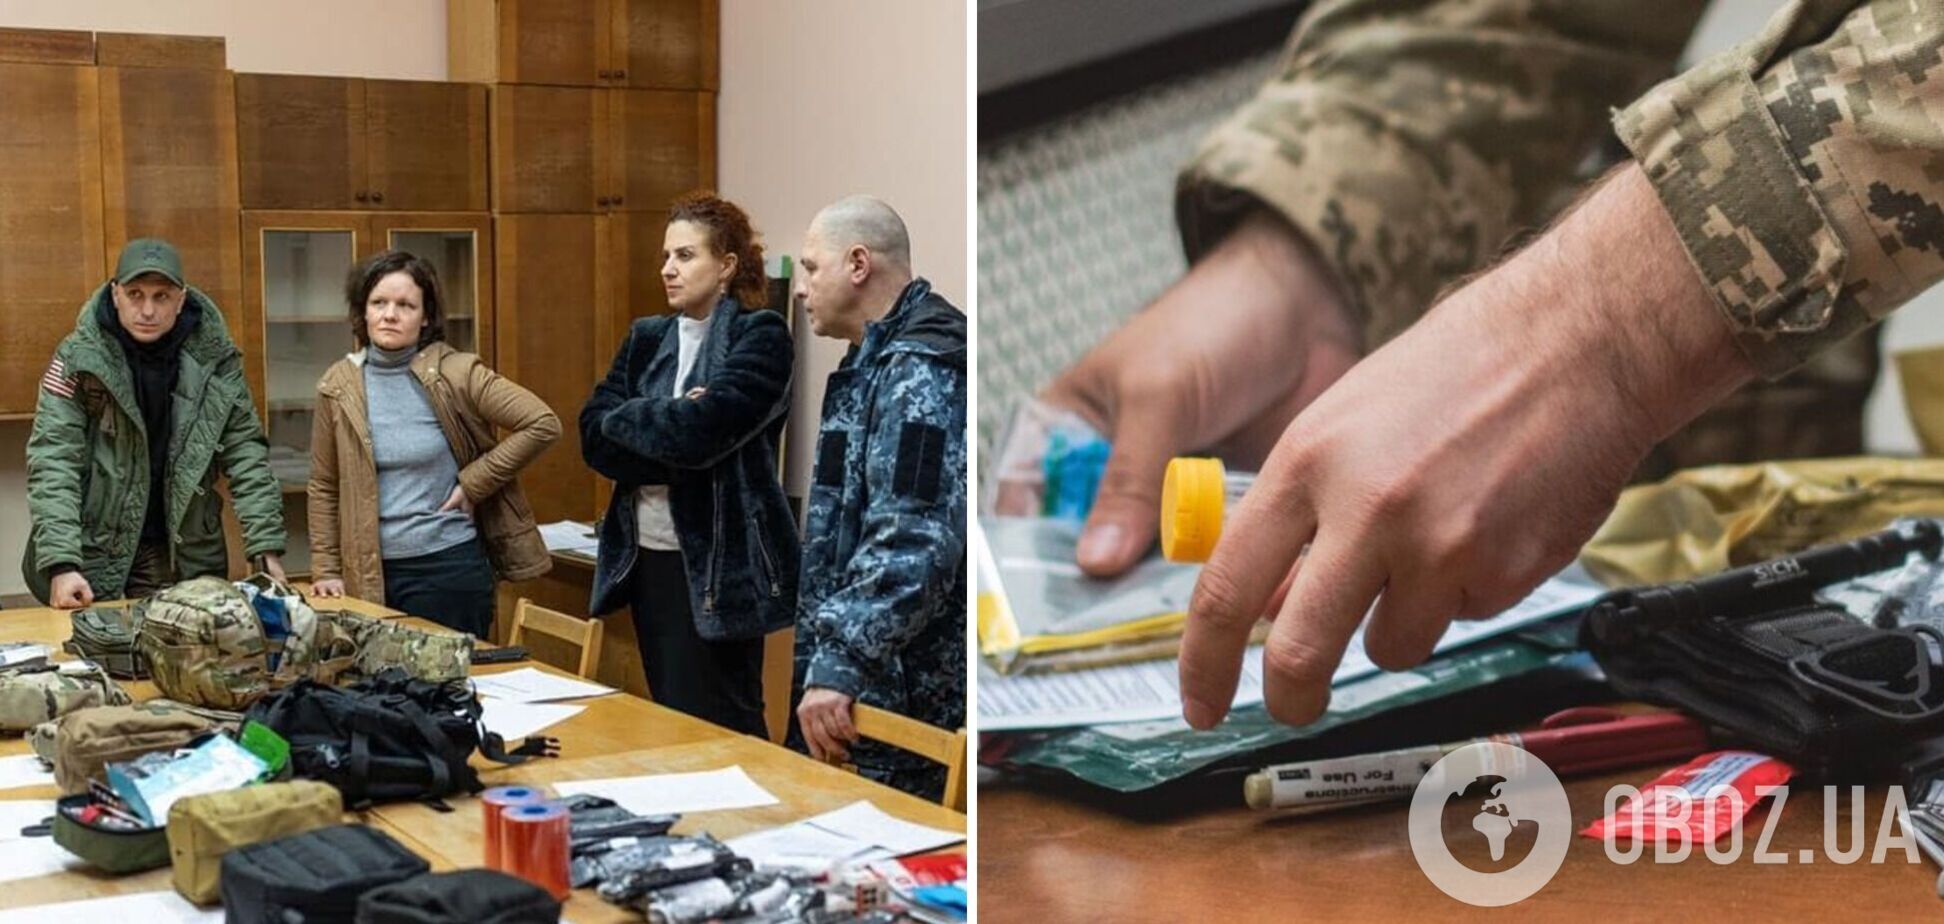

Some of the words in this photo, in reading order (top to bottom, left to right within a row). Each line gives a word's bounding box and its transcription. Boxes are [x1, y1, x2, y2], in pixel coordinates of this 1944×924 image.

[1754, 558, 1800, 580] SICH
[1322, 771, 1357, 784] Use
[1363, 769, 1394, 782] For
